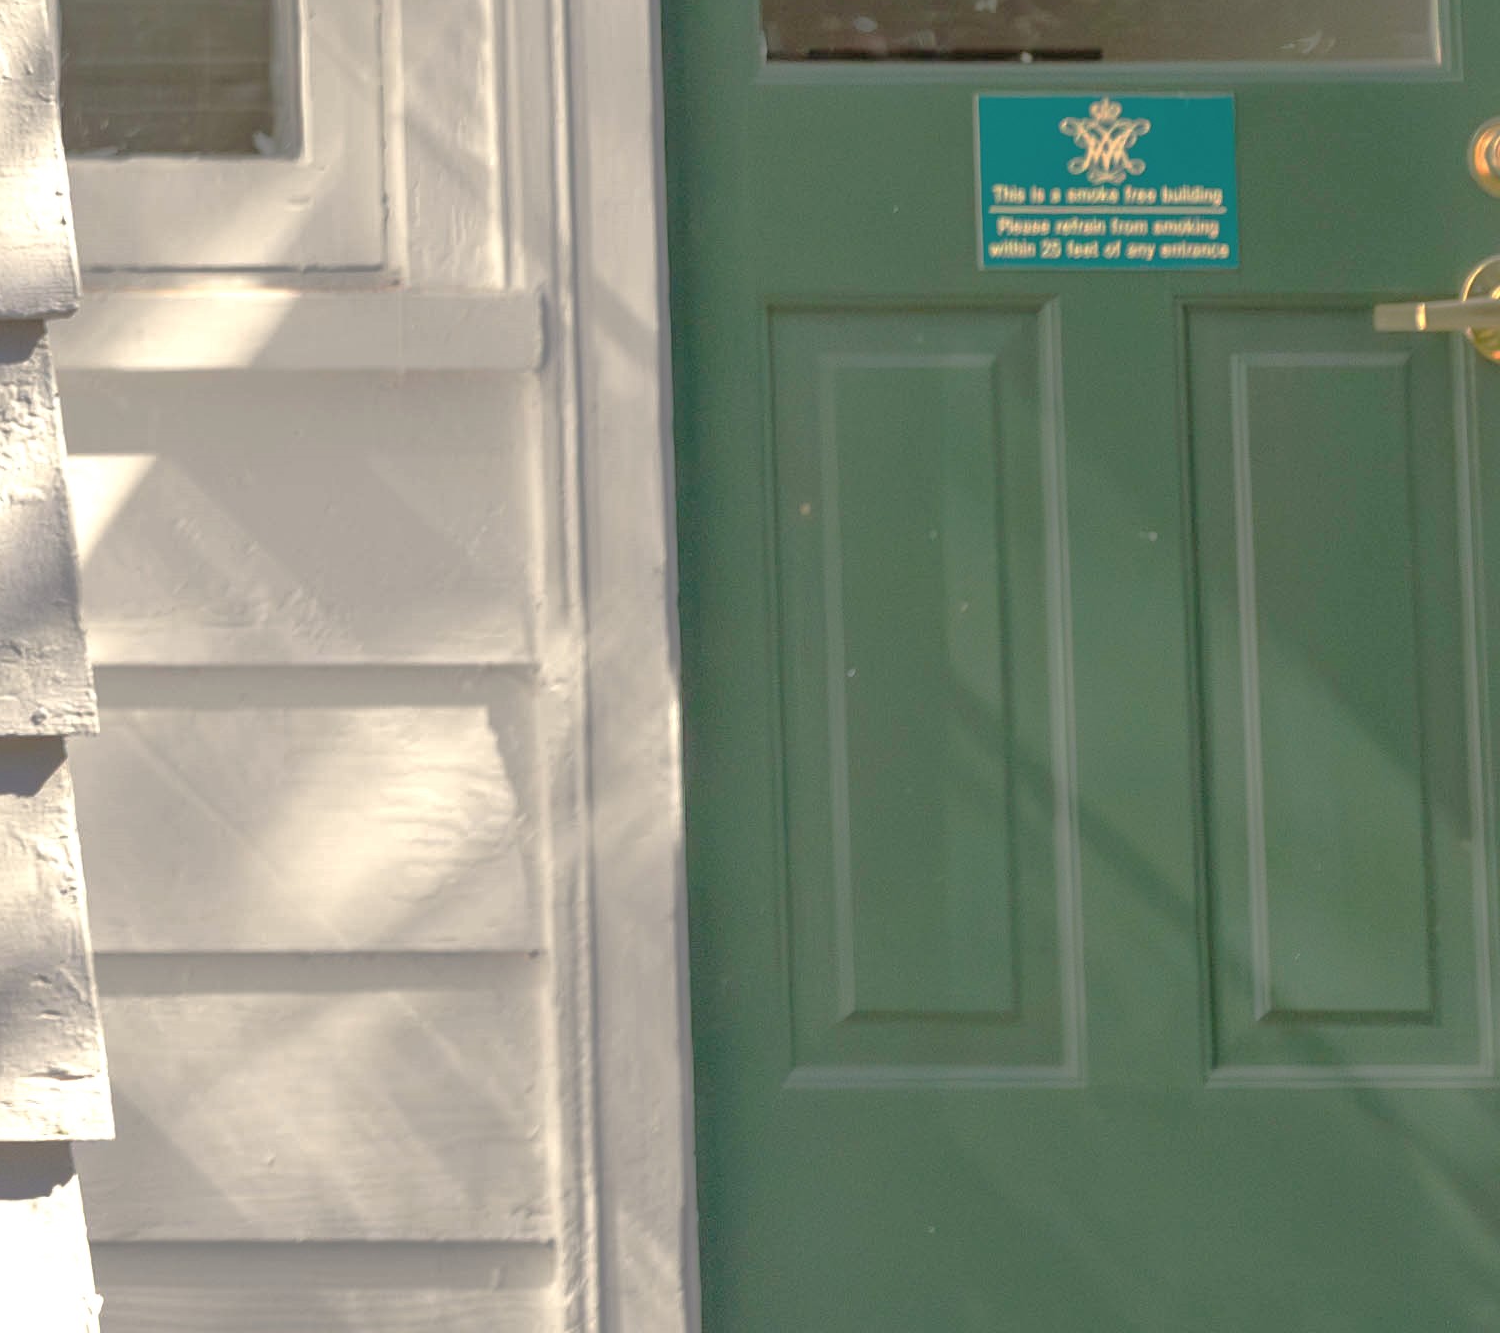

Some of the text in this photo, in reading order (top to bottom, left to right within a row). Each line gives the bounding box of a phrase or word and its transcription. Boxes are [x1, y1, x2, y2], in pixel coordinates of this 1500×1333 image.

[992, 184, 1027, 204] This
[1065, 185, 1120, 204] smoke
[1123, 185, 1157, 204] free
[1160, 185, 1223, 206] building
[996, 216, 1220, 239] Please refrain from smoking
[988, 239, 1037, 259] within
